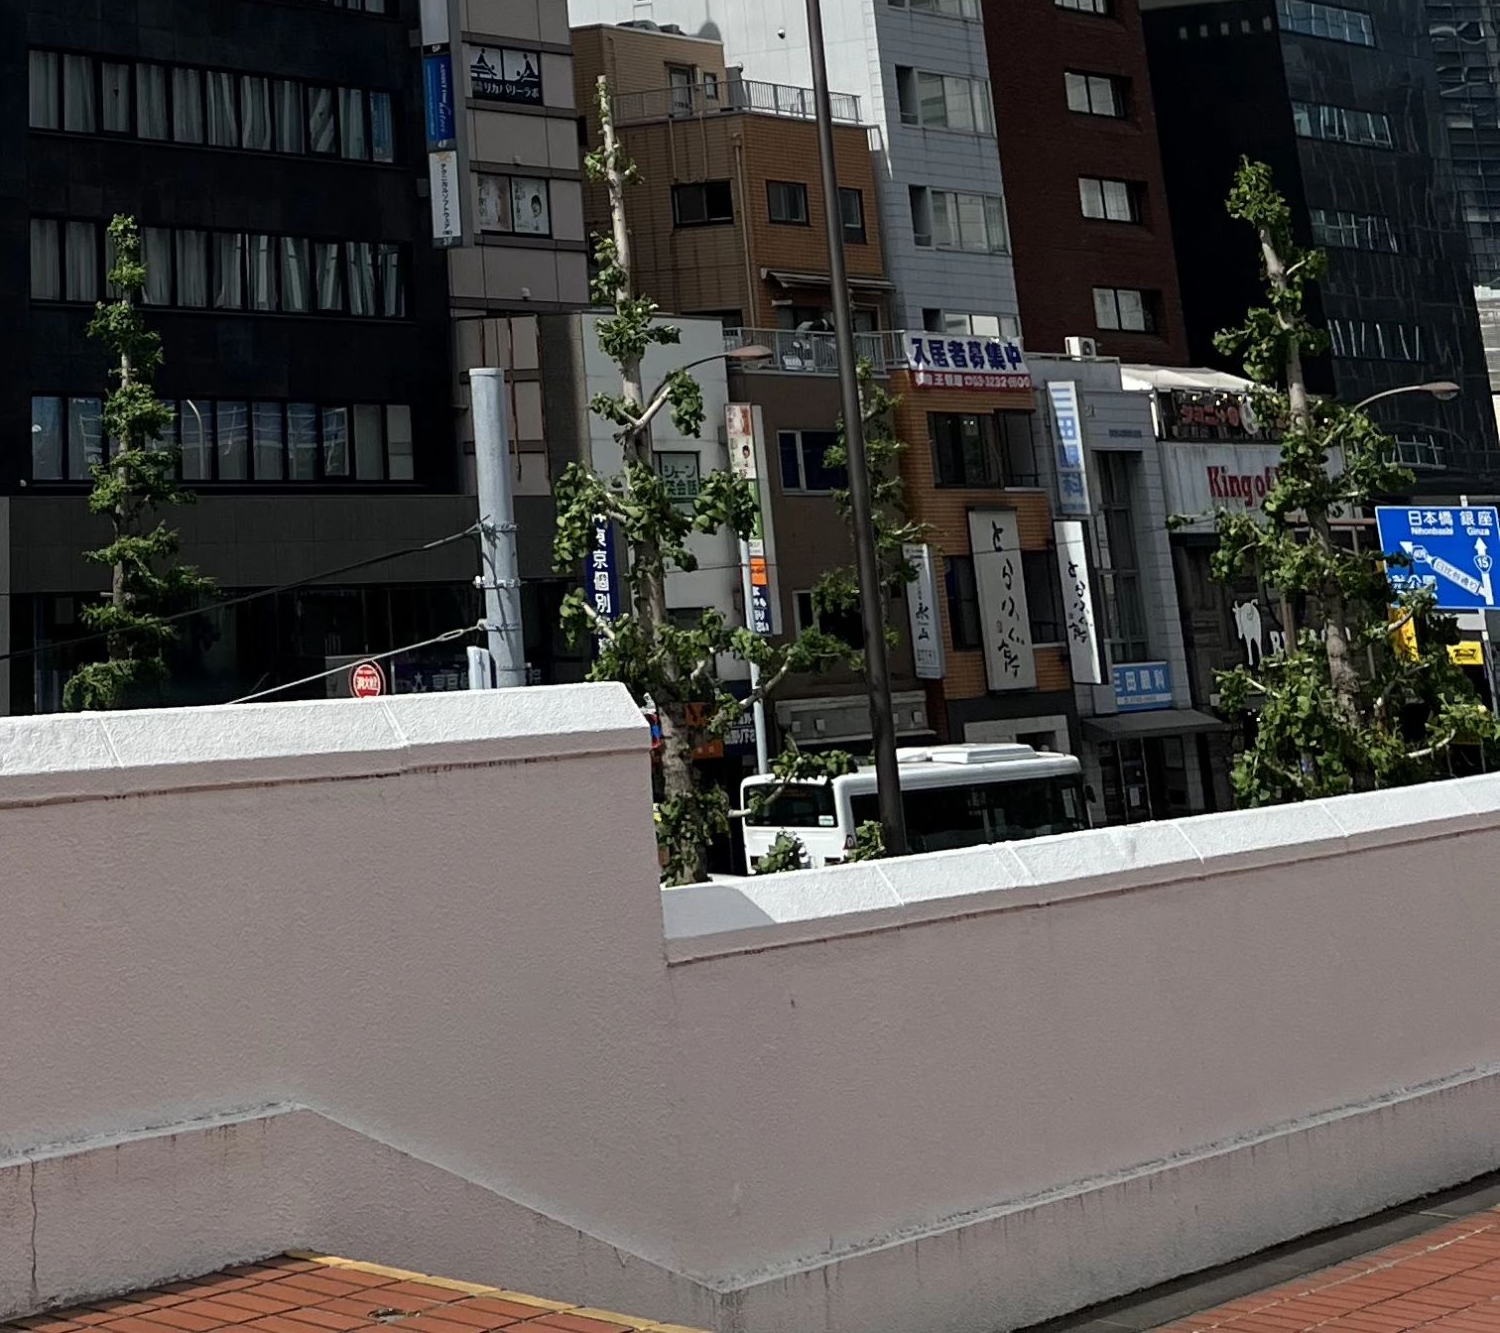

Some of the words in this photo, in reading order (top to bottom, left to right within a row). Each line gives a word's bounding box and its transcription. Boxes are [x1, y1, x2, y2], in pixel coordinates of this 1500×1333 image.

[911, 337, 1024, 371] 入居者募集中
[1050, 387, 1084, 498] 三田眼科
[663, 464, 696, 479] シェーン
[1206, 465, 1254, 508] King
[1407, 510, 1454, 527] 日本橋
[1459, 510, 1493, 527] 銀座
[1466, 526, 1491, 537] Ginza
